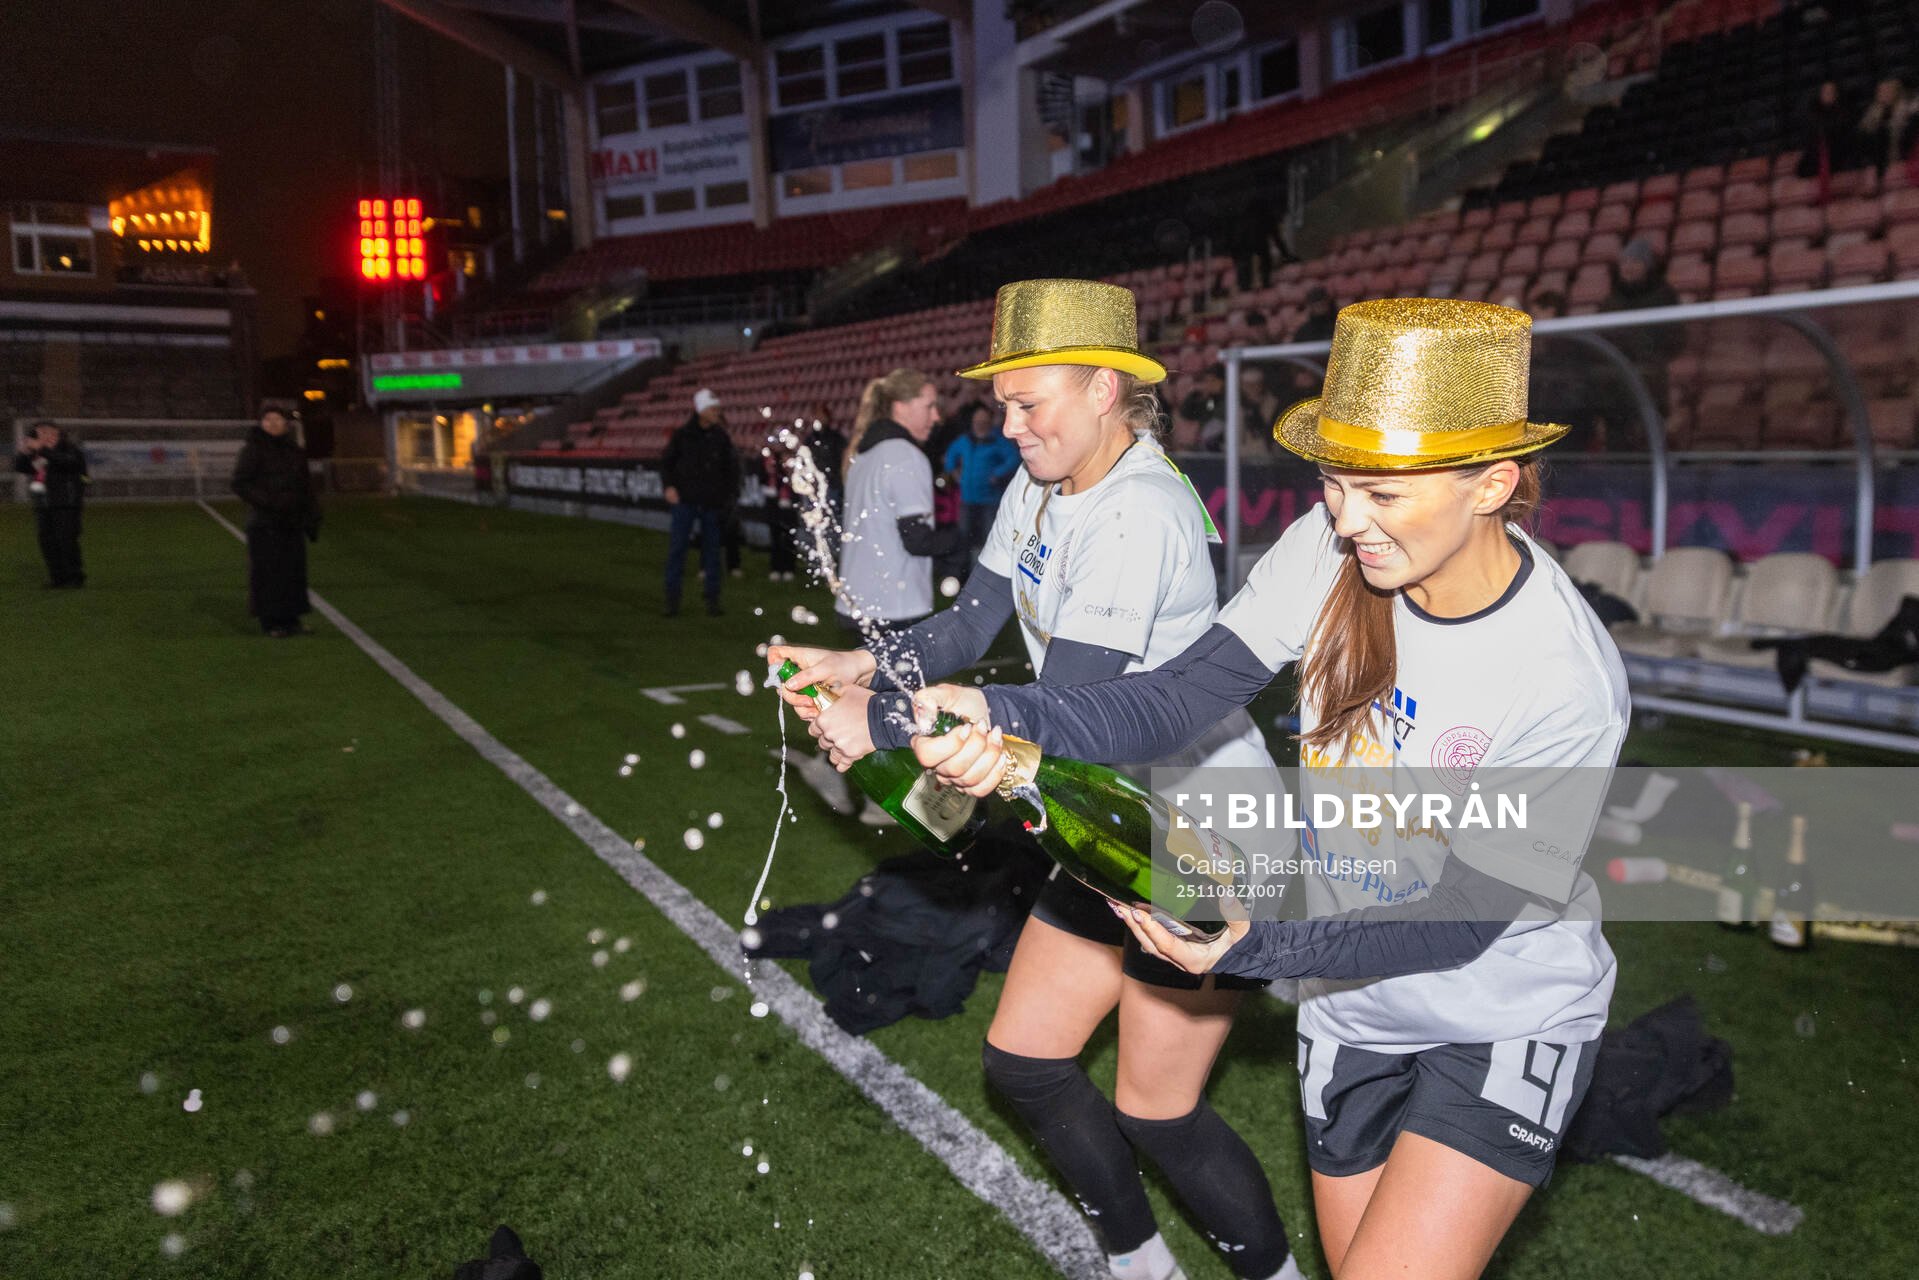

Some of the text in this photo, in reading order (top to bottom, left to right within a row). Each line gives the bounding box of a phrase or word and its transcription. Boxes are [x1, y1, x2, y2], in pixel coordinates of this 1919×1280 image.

[1084, 603, 1129, 618] CRAFT
[1441, 730, 1478, 748] UPPSALA
[1508, 1123, 1547, 1150] CRAFT
